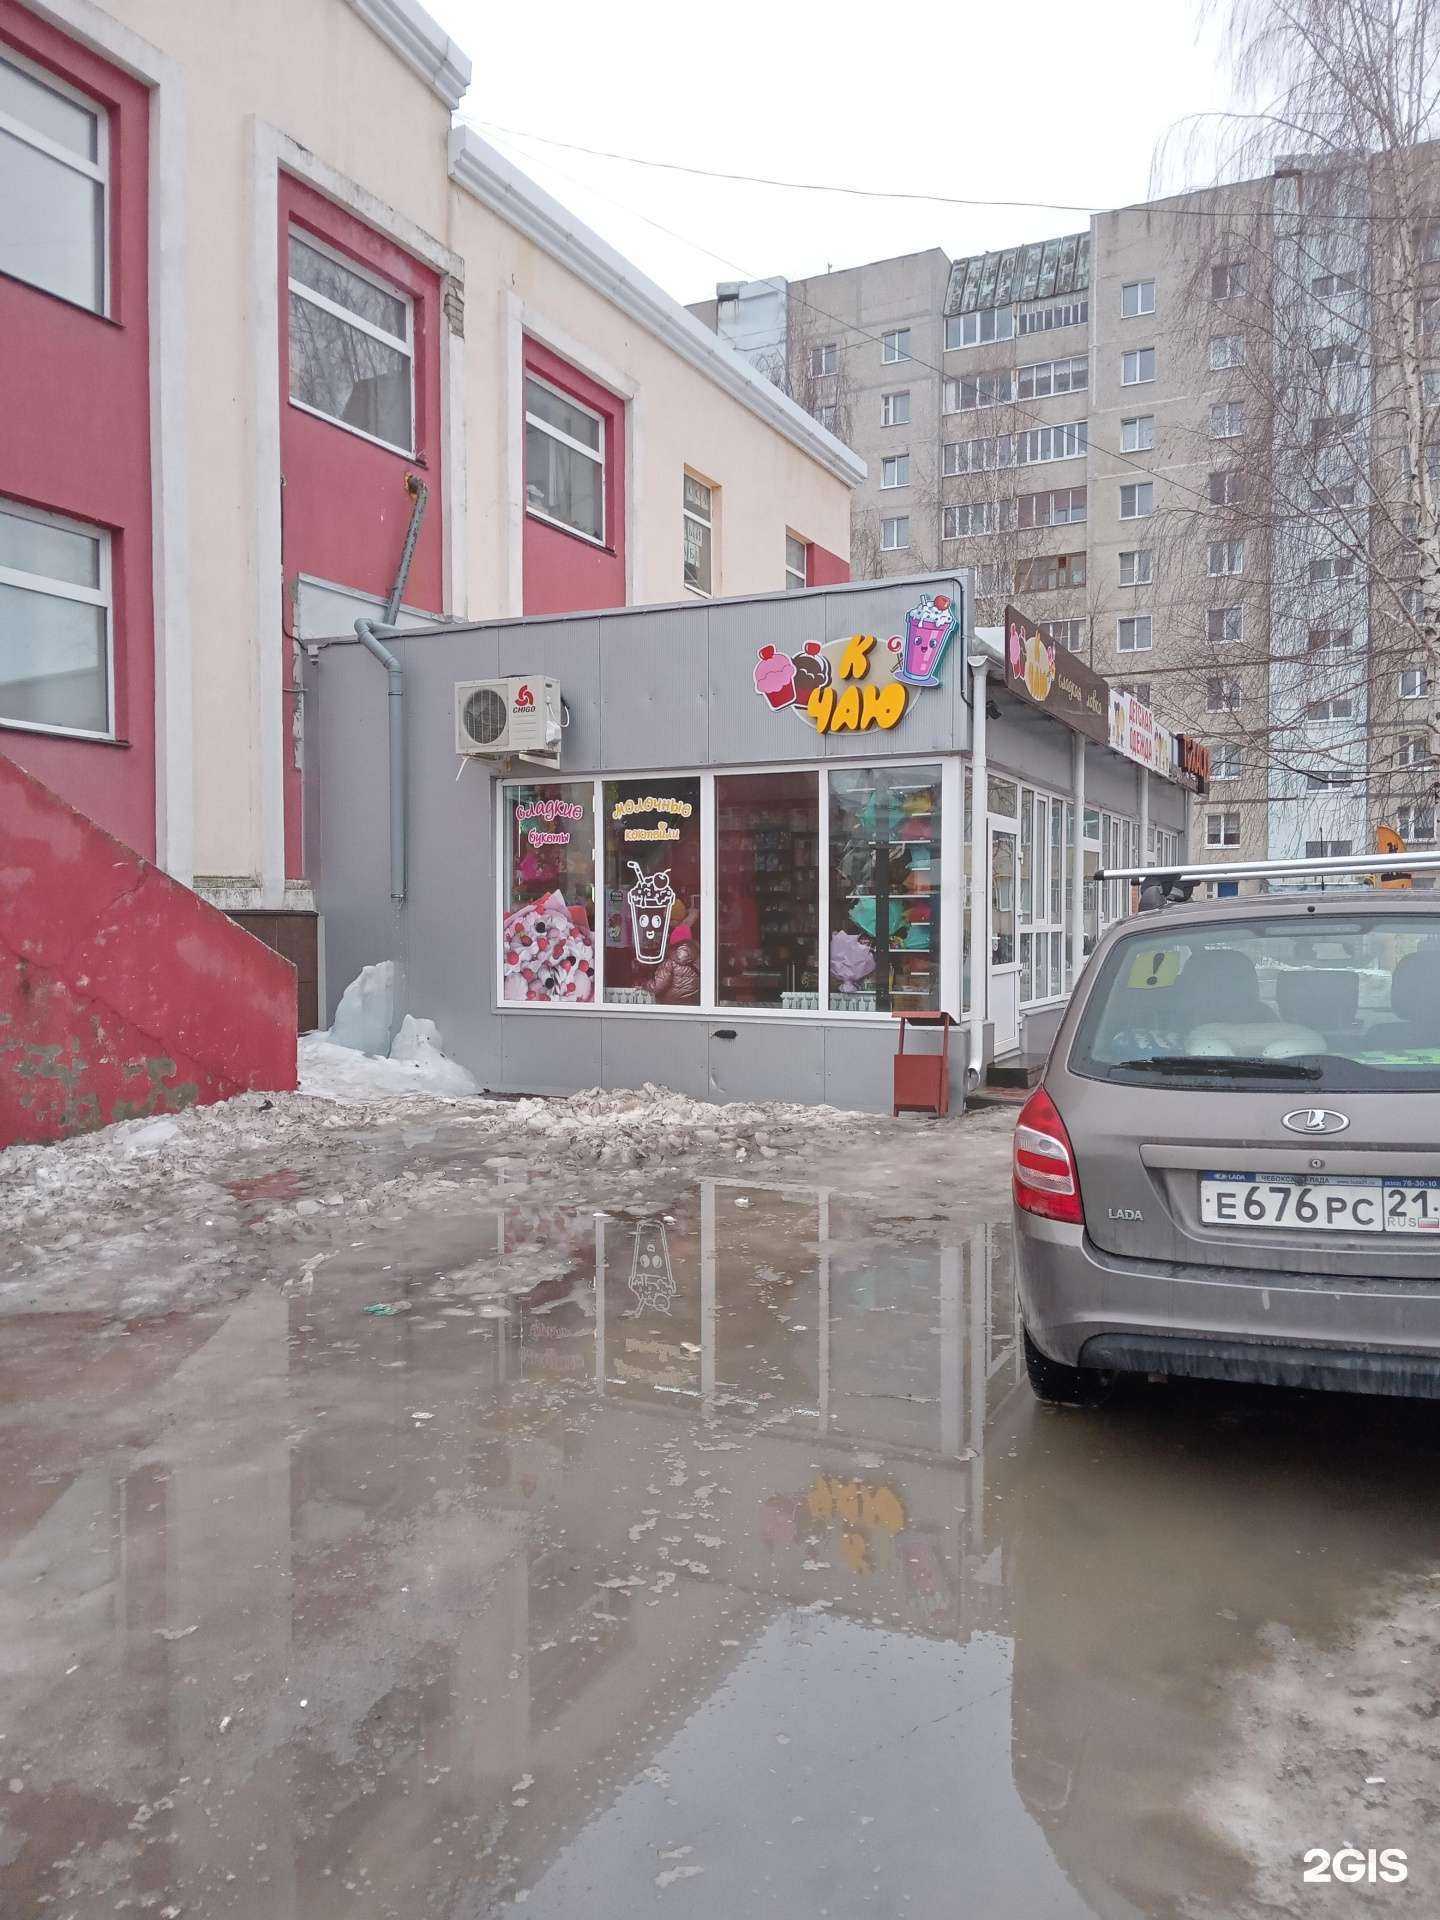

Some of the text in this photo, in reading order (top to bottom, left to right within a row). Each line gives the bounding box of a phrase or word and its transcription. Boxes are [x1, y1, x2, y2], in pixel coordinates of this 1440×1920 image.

[840, 633, 877, 680] К
[512, 705, 536, 714] CHIGO
[807, 682, 909, 736] ЧАЮ
[1128, 698, 1153, 735] ДЕТСКАЯ
[1129, 727, 1153, 763] ОДЕЖДА
[1108, 1208, 1144, 1221] LADA
[1216, 1186, 1429, 1226] Е676РС 21
[1387, 1216, 1417, 1228] RUS
